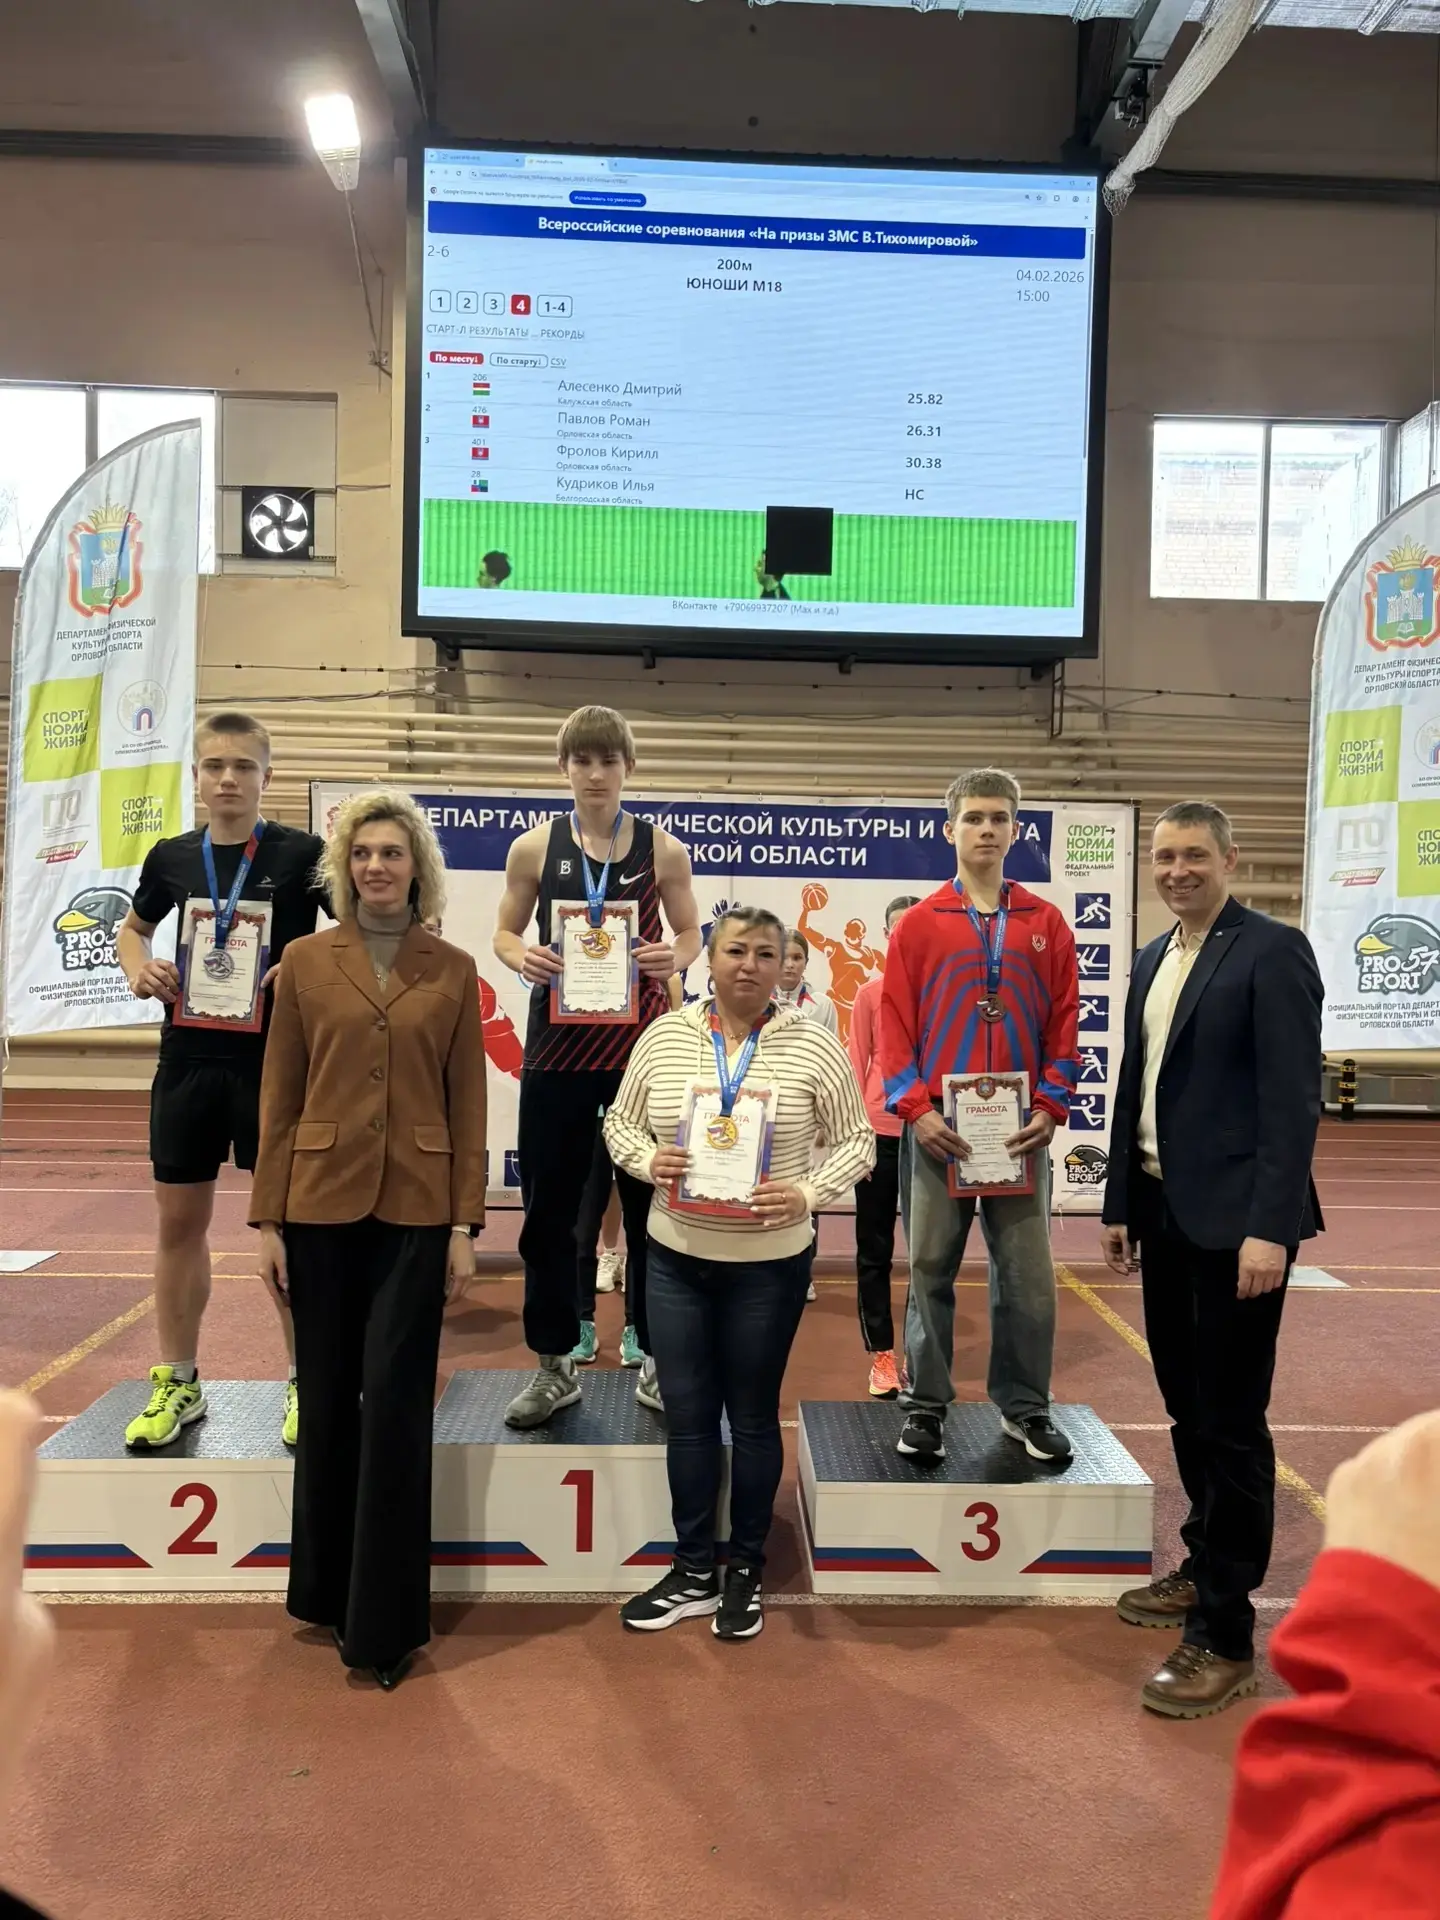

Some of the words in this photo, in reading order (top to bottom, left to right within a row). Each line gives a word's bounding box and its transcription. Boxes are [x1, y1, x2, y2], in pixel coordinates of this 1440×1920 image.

[538, 216, 643, 236] Всероссийские
[646, 222, 745, 240] соревнования
[749, 226, 777, 240] «На
[780, 228, 825, 244] призы
[827, 230, 859, 244] ЗМС
[863, 230, 979, 248] В.Тихомировой»
[427, 246, 451, 258] 2-6
[717, 258, 753, 272] 200м
[1016, 268, 1085, 284] 04.02.2026
[686, 276, 749, 290] ЮНОШИ
[752, 278, 783, 292] М18
[1016, 290, 1050, 302] 15:00
[436, 296, 443, 308] 1
[463, 298, 471, 308] 2
[490, 298, 498, 310] 3
[516, 300, 526, 310] 4
[545, 300, 566, 312] 1-4
[469, 326, 529, 338] РЕЗУЛЬТАТЫ
[540, 328, 585, 340] РЕКОРДЫ
[435, 354, 448, 362] По
[496, 356, 508, 364] По
[551, 358, 567, 368] CSV
[472, 374, 488, 382] 206
[558, 380, 620, 392] Алесенко
[623, 382, 682, 398] Дмитрий
[557, 398, 599, 406] Калужская
[601, 398, 633, 408] область
[907, 392, 943, 404] 25.82
[425, 404, 431, 412] 2
[472, 406, 487, 414] 476
[558, 412, 606, 424] Павлов
[609, 414, 651, 426] Роман
[556, 430, 600, 440] Орловская
[601, 432, 633, 440] область
[906, 424, 942, 436] 26.31
[424, 436, 430, 444] 3
[471, 438, 486, 446] 401
[556, 444, 608, 458] Фролов
[611, 446, 659, 460] Кирилл
[556, 462, 600, 472] Орловская
[601, 464, 633, 472] область
[905, 456, 942, 468] 30.38
[556, 476, 619, 492] Кудриков
[622, 478, 655, 492] Илья
[556, 494, 610, 504] Белгородская
[611, 496, 643, 504] область
[672, 600, 718, 612] ВКонтакте
[724, 602, 788, 614] +79069937207
[57, 627, 107, 641] ДЕПАРТАМЕН
[112, 630, 142, 641] СПОРТА
[108, 641, 143, 653] ОБЛАСТИ
[1354, 659, 1405, 674] ДЕПАРТАМЕНТ
[1365, 670, 1406, 683] КУЛЬТУРЫ
[1364, 679, 1407, 694] ОРЛОВСКОЙ
[44, 732, 88, 749] ЖИЗНИ
[1338, 749, 1384, 766] НОРМА
[1338, 761, 1384, 777] ЖИЗНИ
[122, 796, 154, 811] СПОРТ
[122, 807, 163, 823] НОРМА
[122, 820, 163, 836] ЖИЗНИ
[781, 817, 911, 838] КУЛЬТУРЫ
[918, 819, 935, 839] И
[1067, 824, 1107, 837] СПОРТ
[1066, 837, 1114, 850] НОРМА
[750, 845, 868, 867] ОБЛАСТИ
[1066, 850, 1114, 862] ЖИЗНИ
[1064, 862, 1115, 870] ФЕДЕРАЛЬНЫЙ
[65, 929, 106, 951] PRO
[66, 946, 120, 969] SPOR
[1361, 955, 1402, 974] PRO
[1400, 945, 1440, 976] 57
[29, 979, 86, 994] ОФИЦИАЛЬНЫЙ
[87, 977, 114, 987] ПОРТАЛ
[1360, 971, 1422, 990] SPORT
[40, 988, 87, 1001] ФИЗИЧЕСКОЙ
[88, 985, 126, 997] КУЛЬТУРЫ
[64, 995, 105, 1008] ОРЛОВСКОЙ
[1327, 1002, 1381, 1012] ОФИЦИАЛЬНЫЙ
[1382, 1002, 1411, 1011] ПОРТАЛ
[1336, 1012, 1382, 1020] ФИЗИЧЕСКОЙ
[1383, 1010, 1422, 1020] КУЛЬТУРЫ
[1423, 1010, 1429, 1018] И
[1359, 1020, 1401, 1029] ОРЛОВСКОЙ
[1402, 1019, 1434, 1028] ОБЛАСТИ
[965, 1105, 1008, 1115] ГРАМОТА
[1068, 1164, 1088, 1173] PRO
[1068, 1173, 1100, 1182] SPORT
[561, 1469, 594, 1553] 1
[168, 1482, 218, 1556] 2
[961, 1501, 1001, 1561] 3
